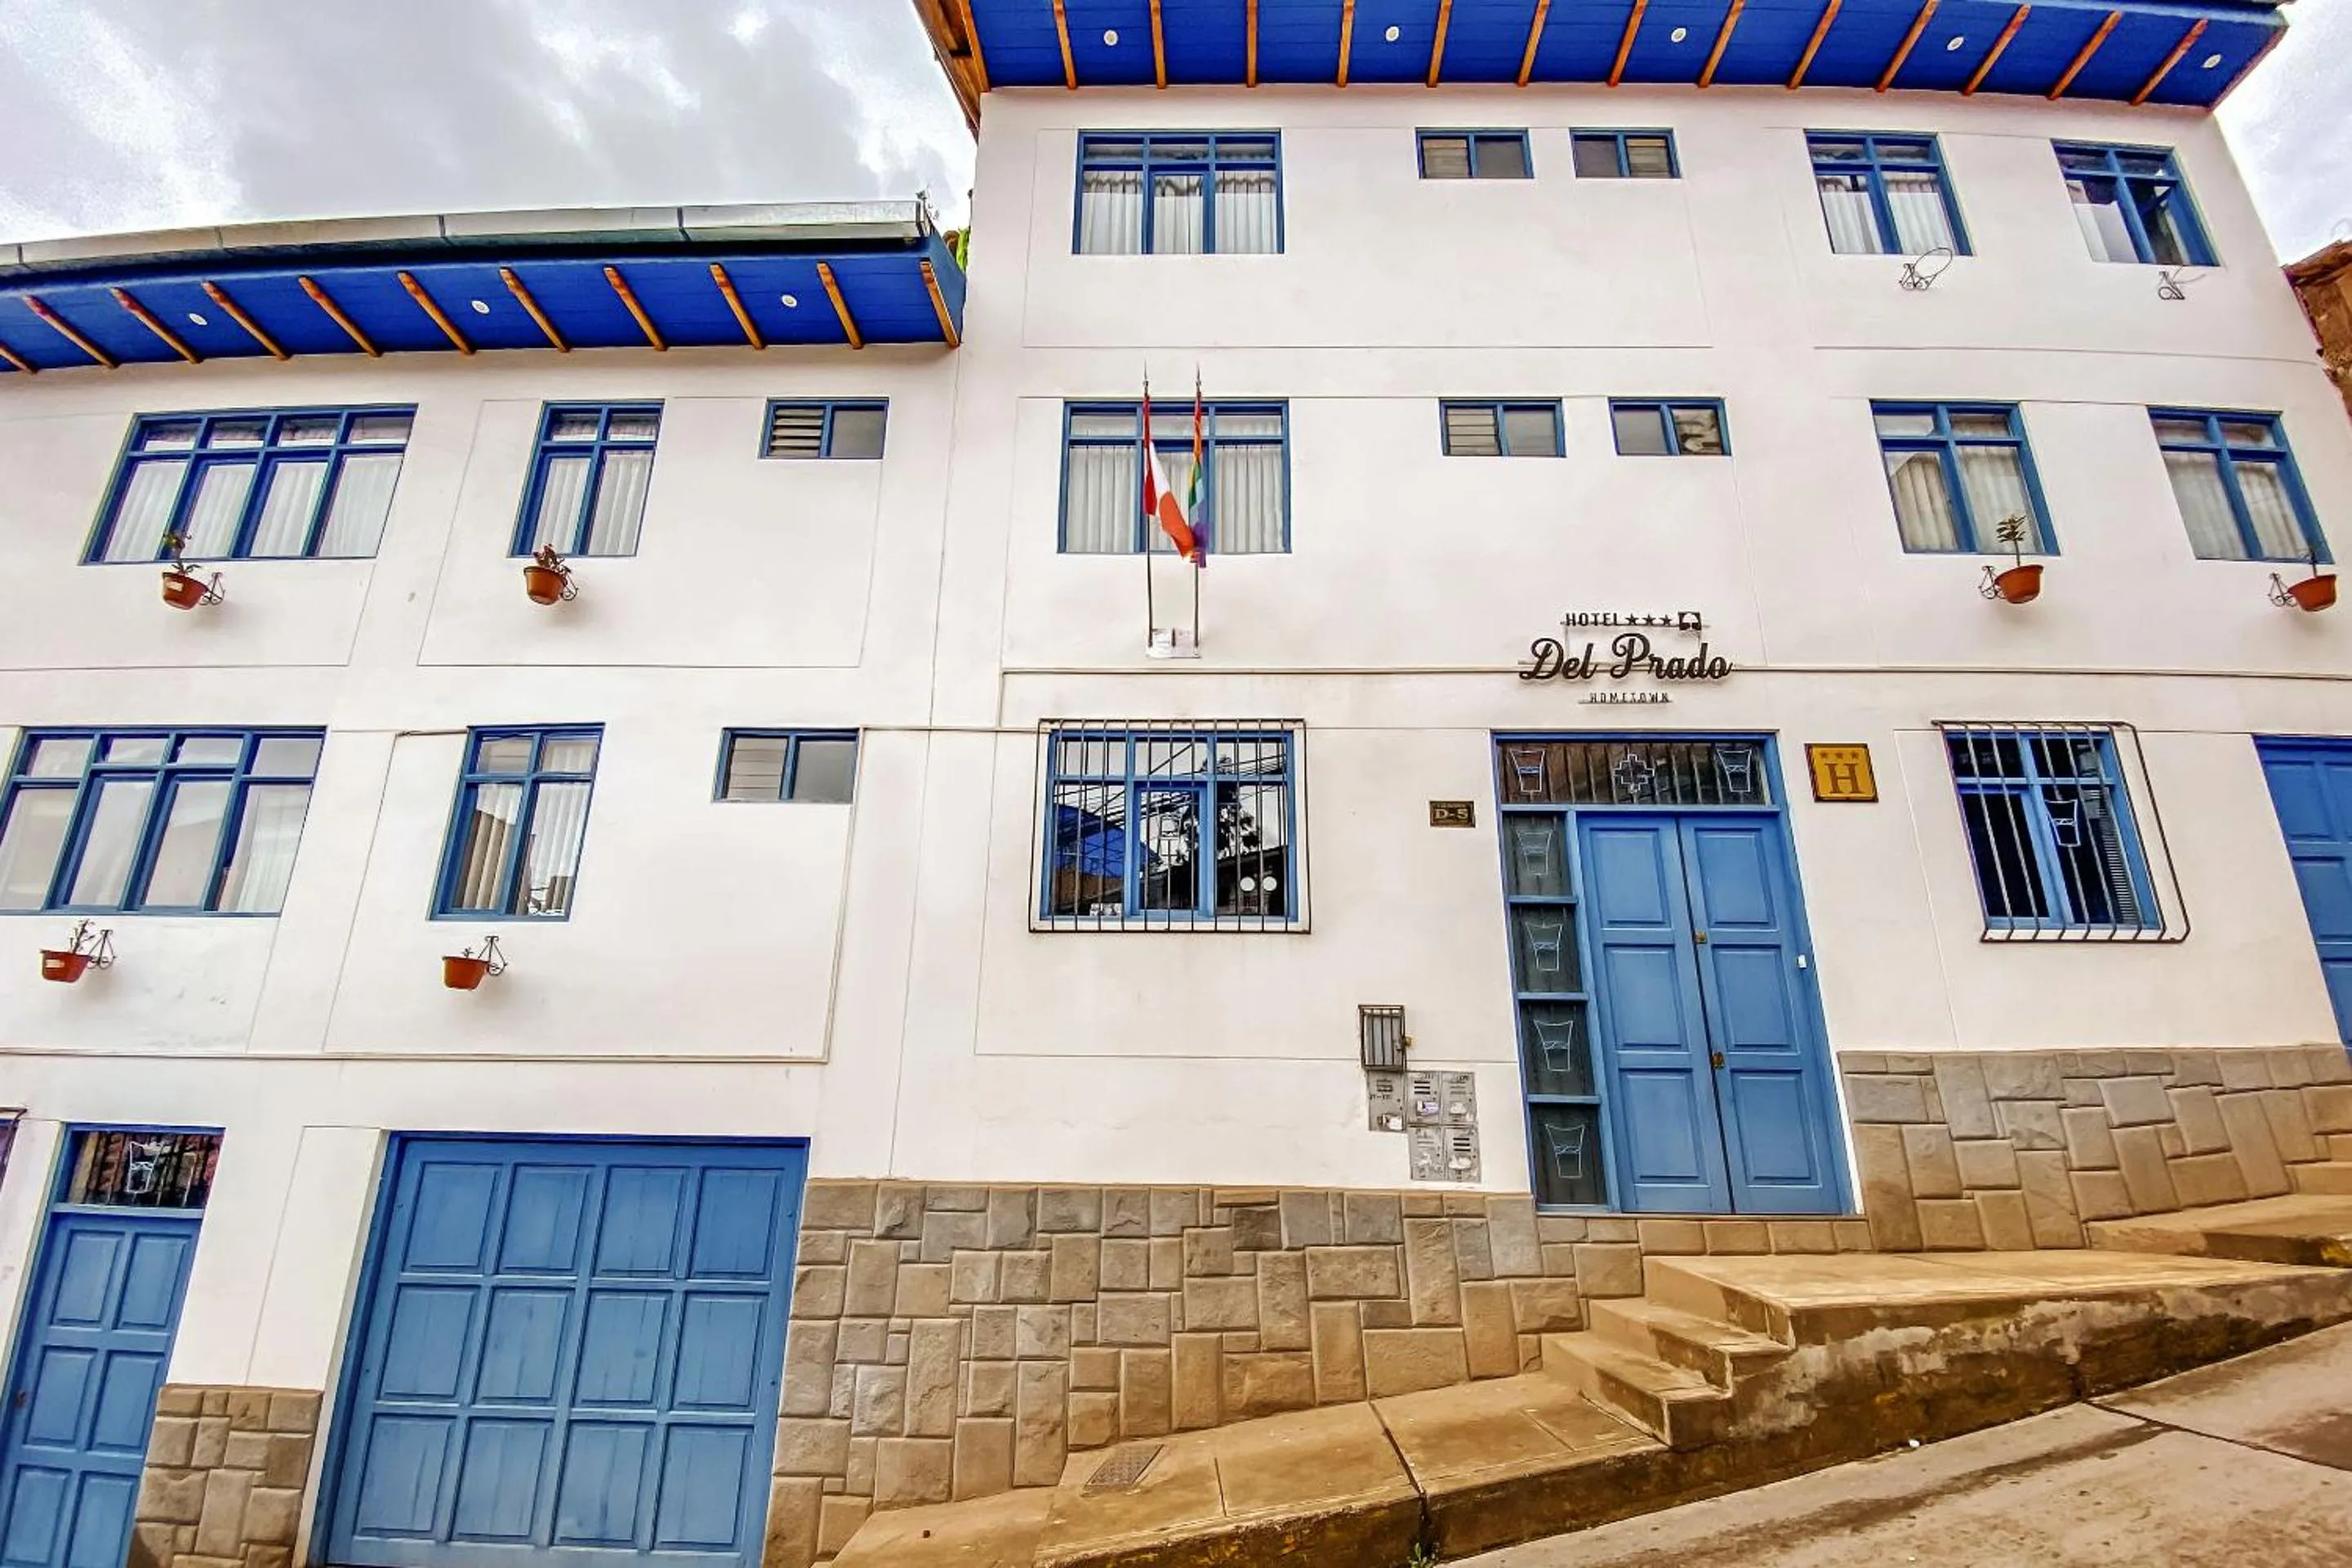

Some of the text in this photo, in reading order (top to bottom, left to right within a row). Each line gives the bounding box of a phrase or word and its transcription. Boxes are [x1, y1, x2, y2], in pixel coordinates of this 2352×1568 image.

[1566, 612, 1619, 626] HOTEL
[1519, 633, 1733, 679] Del Prado
[1589, 693, 1670, 703] HOMETOWN
[1824, 763, 1865, 794] H
